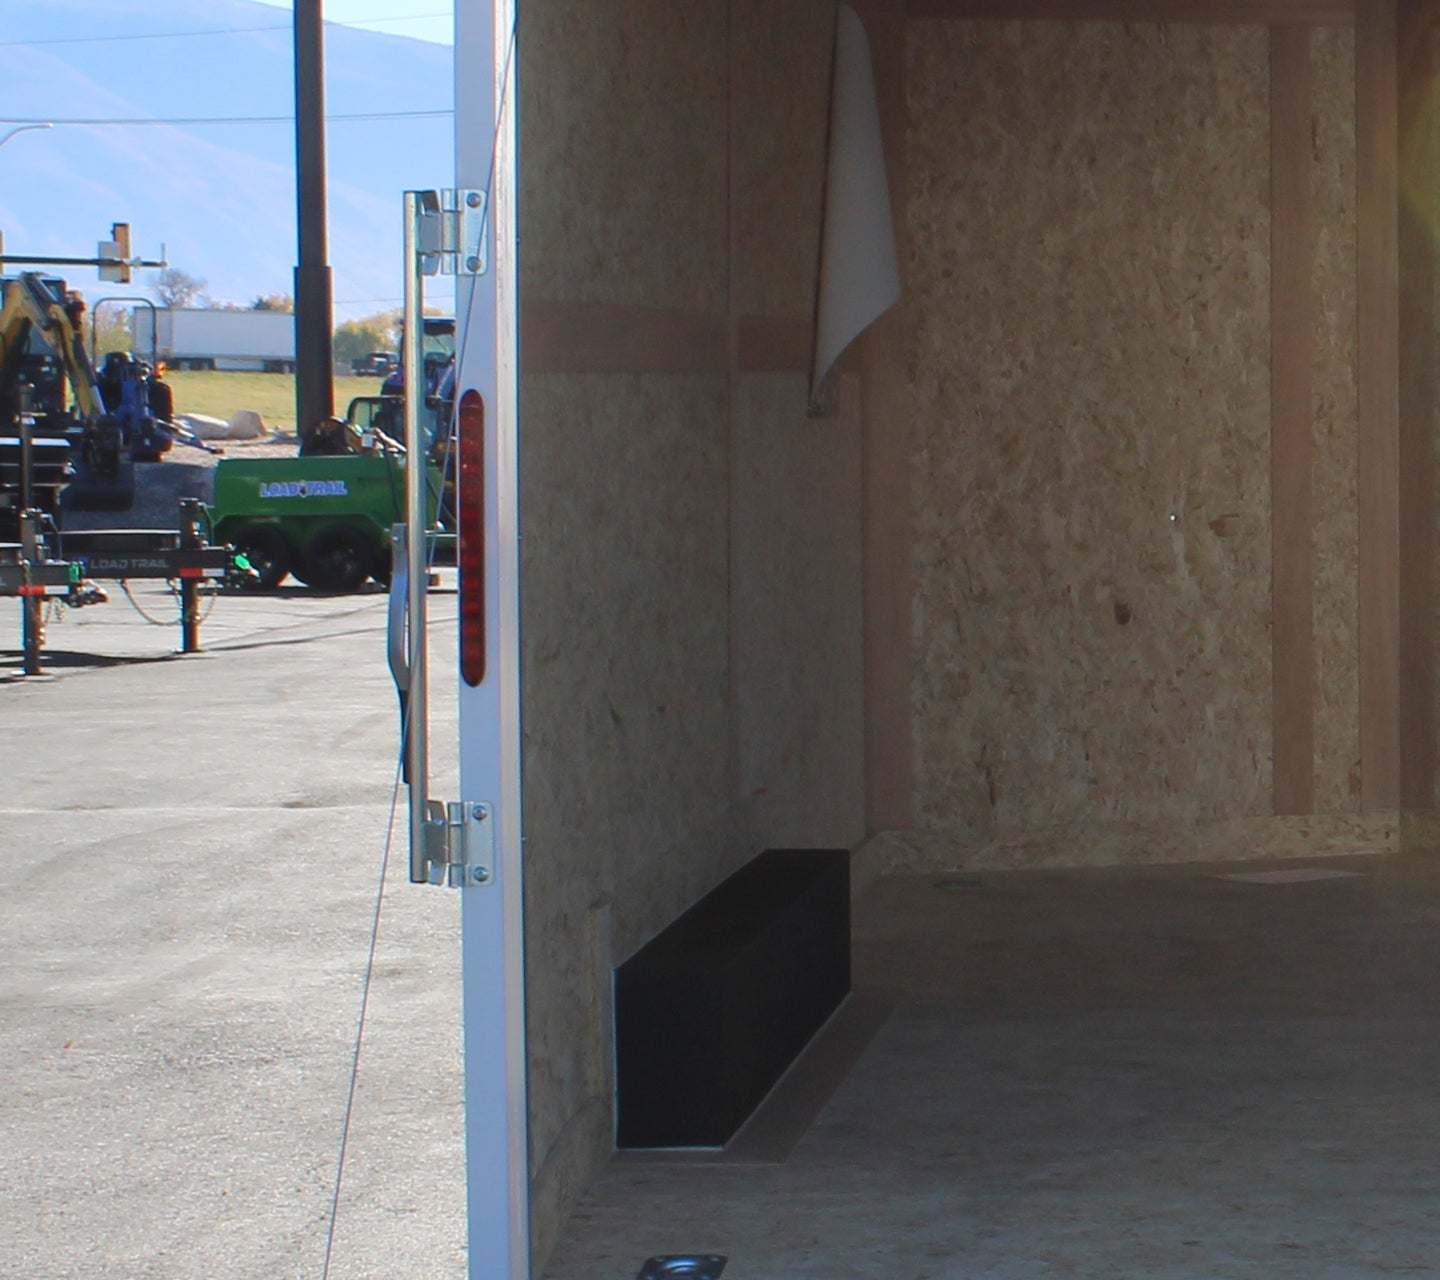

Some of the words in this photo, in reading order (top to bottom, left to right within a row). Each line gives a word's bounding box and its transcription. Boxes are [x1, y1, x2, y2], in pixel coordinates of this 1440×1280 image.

[260, 482, 300, 498] LOAD
[305, 480, 348, 496] TRAIL
[90, 559, 129, 569] LOAD
[132, 558, 169, 569] TRAIL
